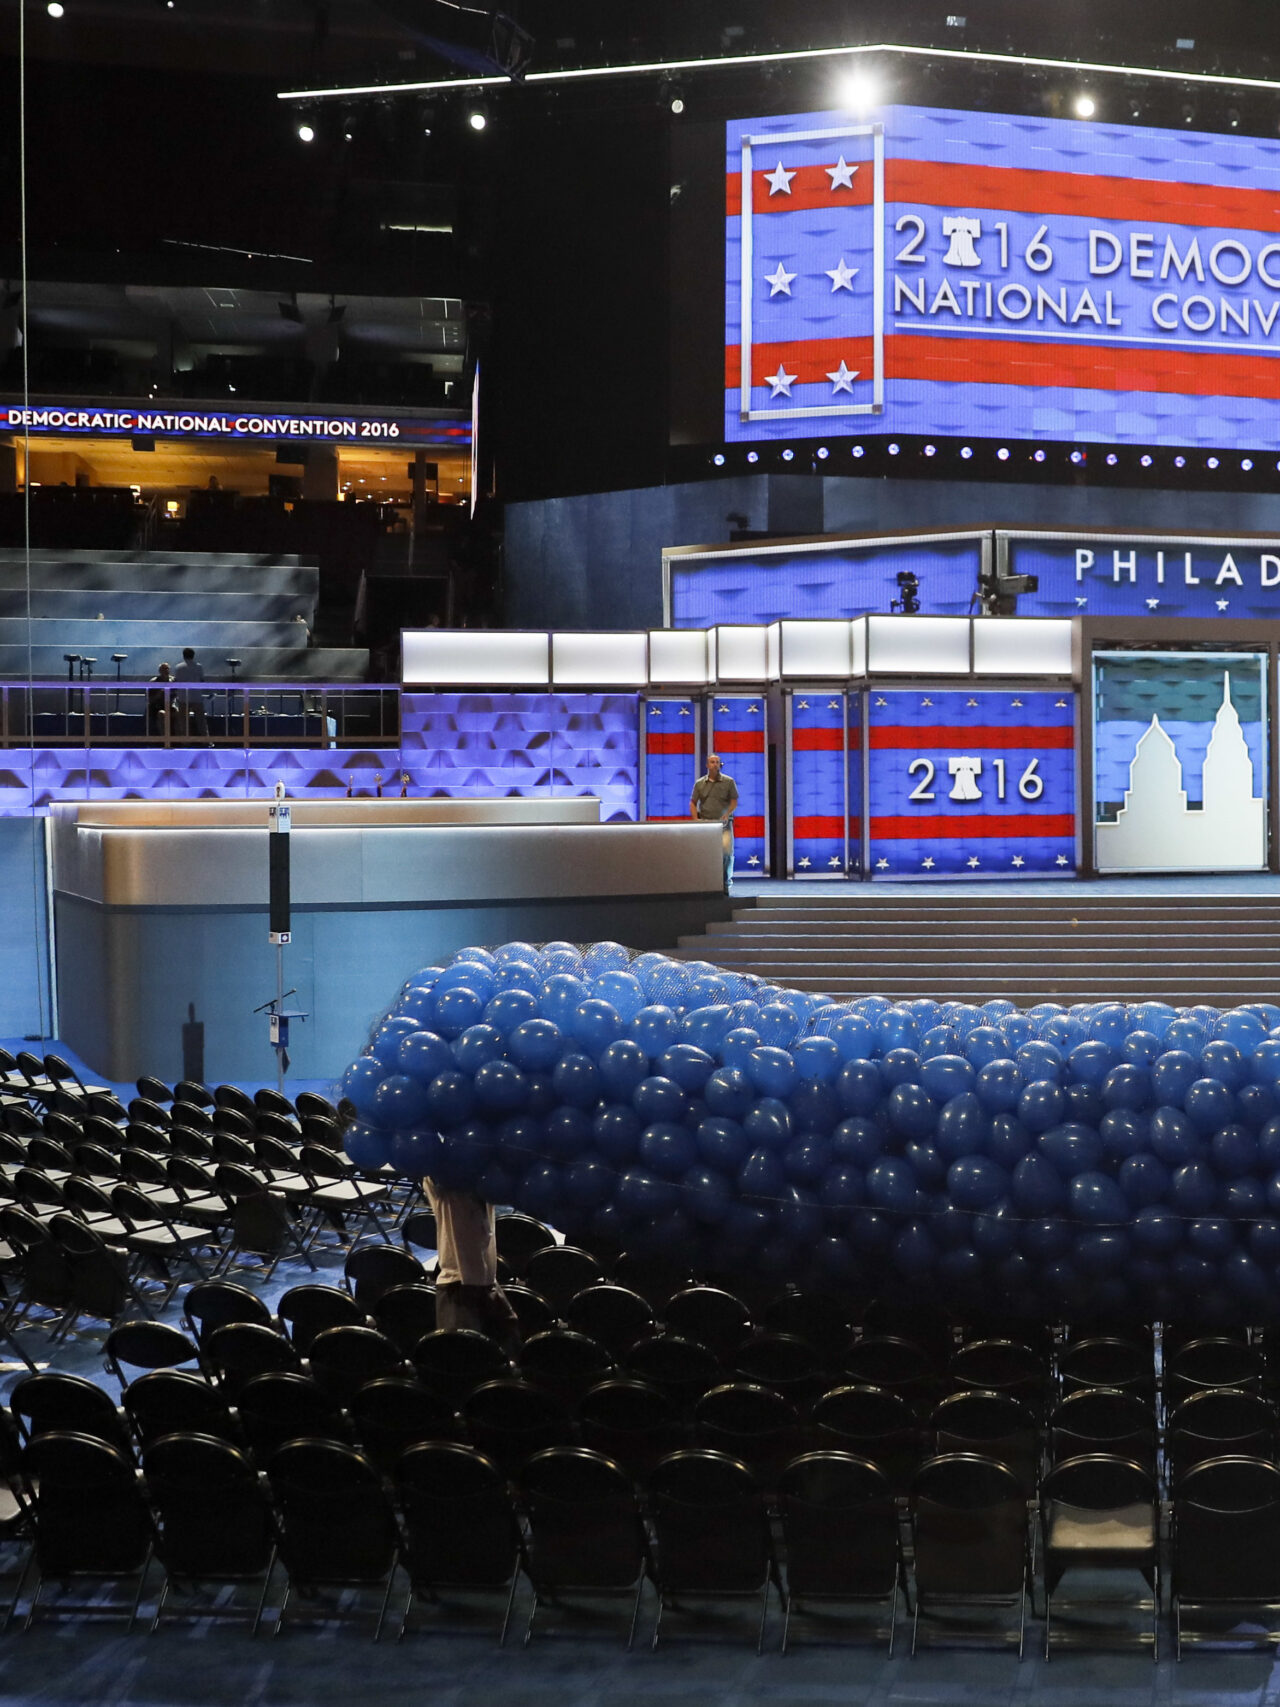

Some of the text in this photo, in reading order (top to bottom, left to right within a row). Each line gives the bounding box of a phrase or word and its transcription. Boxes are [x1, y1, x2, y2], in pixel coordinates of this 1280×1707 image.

[894, 273, 1122, 326] NATIONAL
[8, 409, 400, 437] DEMOCRATIC NATIONAL CONVENTION 2016
